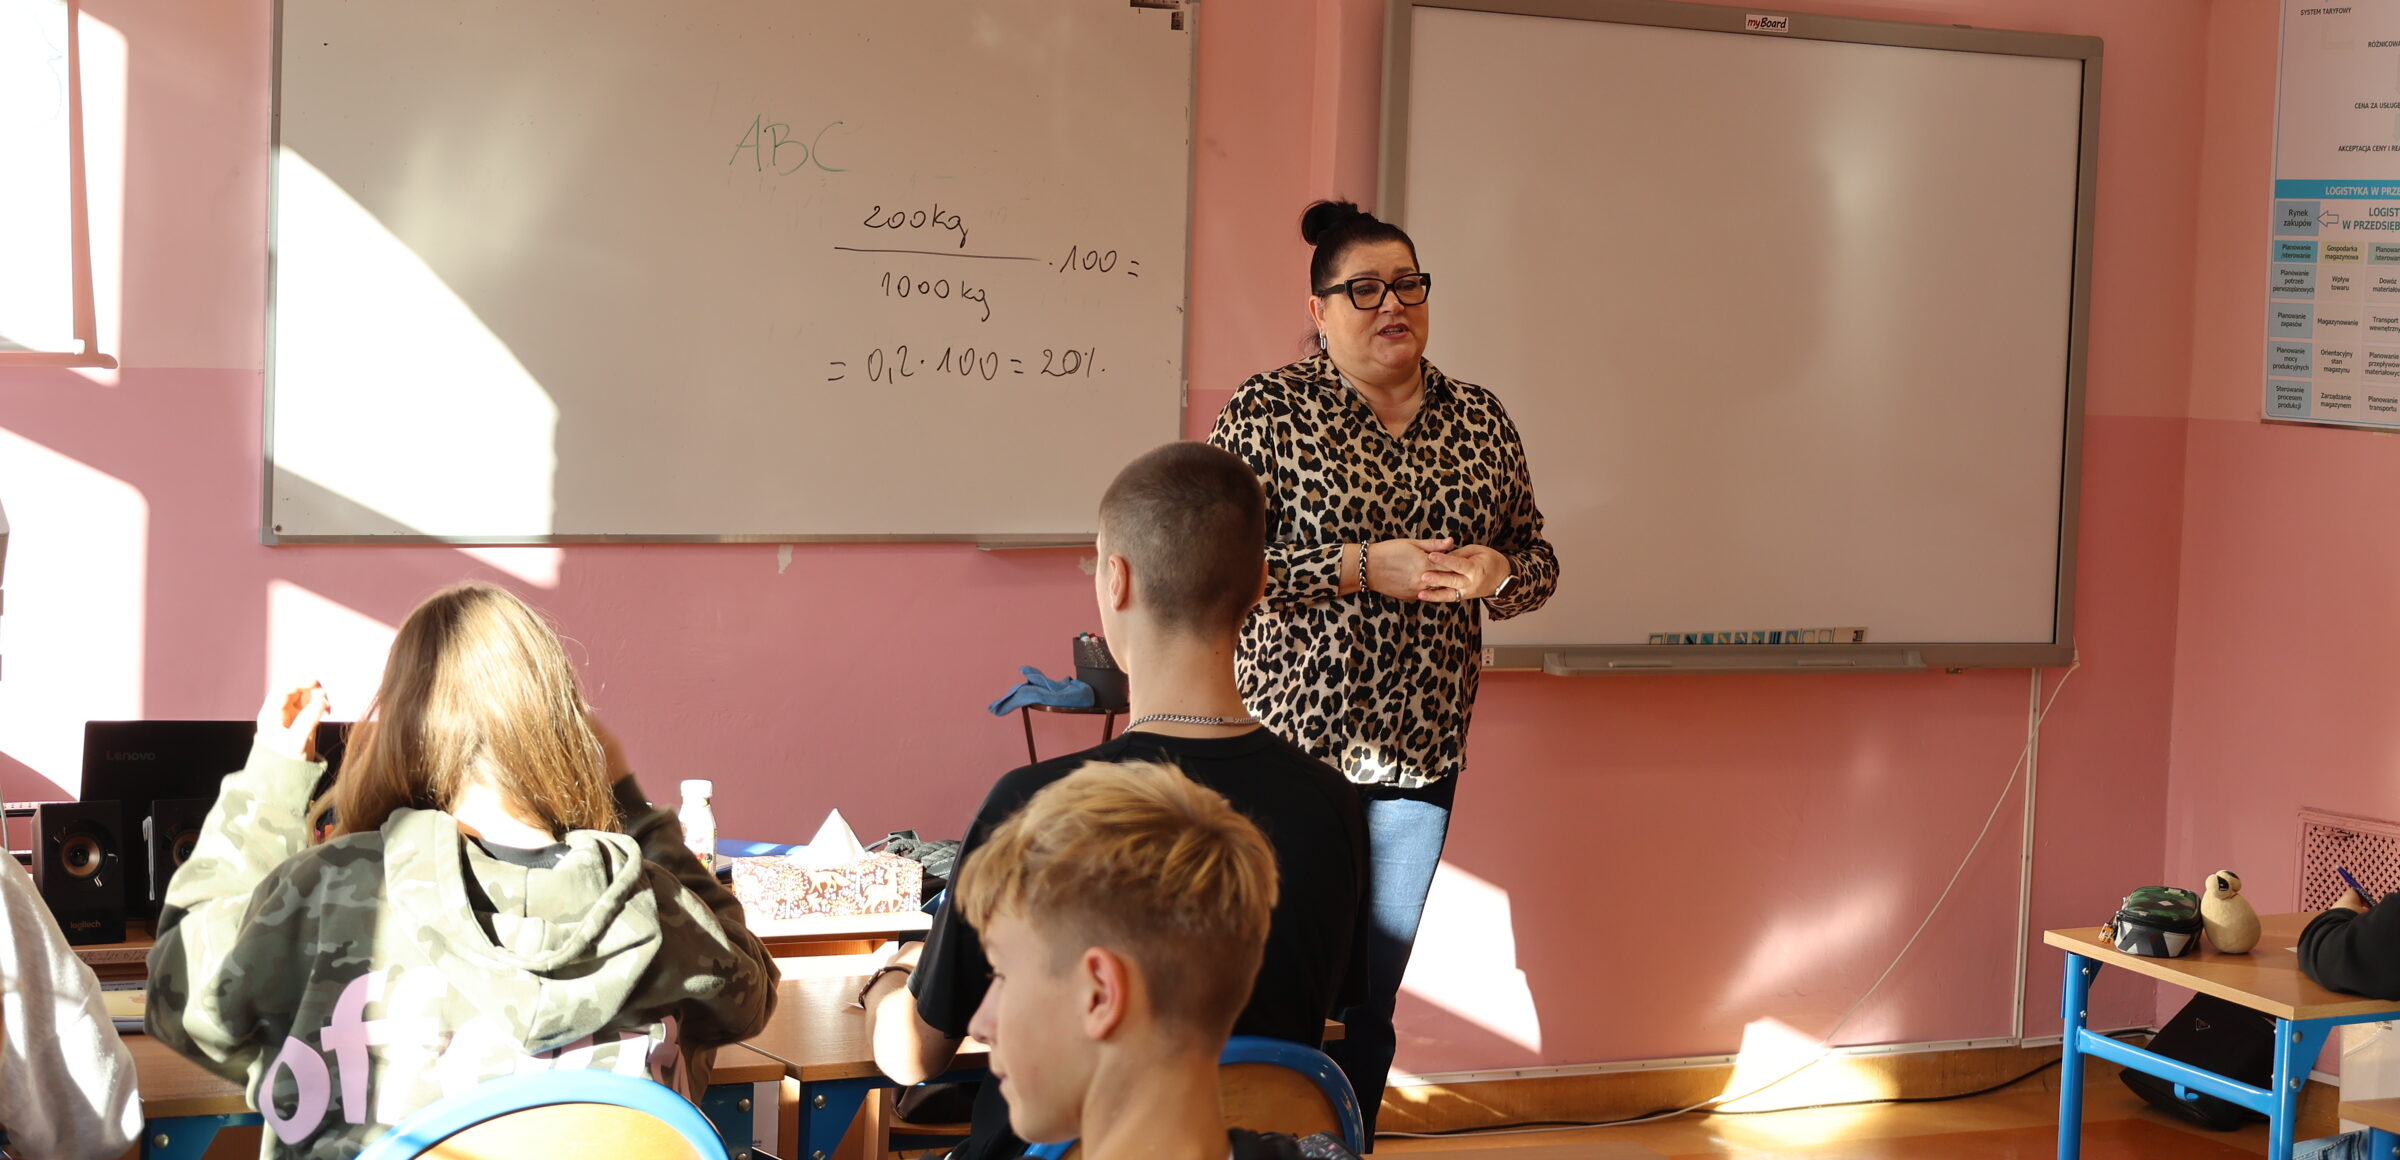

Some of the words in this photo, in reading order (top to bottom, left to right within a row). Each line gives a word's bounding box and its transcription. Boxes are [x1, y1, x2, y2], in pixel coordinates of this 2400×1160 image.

[2323, 7, 2352, 15] TARYFOWY
[1747, 16, 1787, 30] myBoard
[729, 114, 849, 176] ABC
[2325, 186, 2369, 196] LOGISTYKA
[2370, 187, 2380, 196] W
[2381, 187, 2400, 196] PRZE
[2288, 208, 2309, 218] Rynek
[2283, 219, 2312, 229] zakupów
[2342, 220, 2351, 230] W
[2353, 220, 2400, 233] PRZEDSIĘB
[2280, 269, 2310, 277] Planowanie
[2332, 275, 2350, 284] Wpływ
[2379, 277, 2397, 285] Dowóz
[2277, 312, 2307, 320] Planowanie
[2373, 316, 2399, 324] Transport
[2317, 317, 2359, 326] Magazynowanie
[2276, 347, 2305, 355] Planowanie
[2320, 349, 2353, 359] Orientacyjny
[2369, 351, 2400, 360] Planowanie
[2272, 363, 2310, 372] produkcyjnych
[2323, 366, 2351, 375] magazynu
[2276, 385, 2305, 393] Sterowanie
[2320, 392, 2352, 401] Zarządzanie
[2368, 395, 2399, 404] Planowanie
[2277, 402, 2302, 411] produkcji
[2320, 401, 2352, 409] magazynem
[2368, 404, 2398, 413] transportu
[105, 749, 157, 761] Lenovo
[70, 920, 101, 931] logitech
